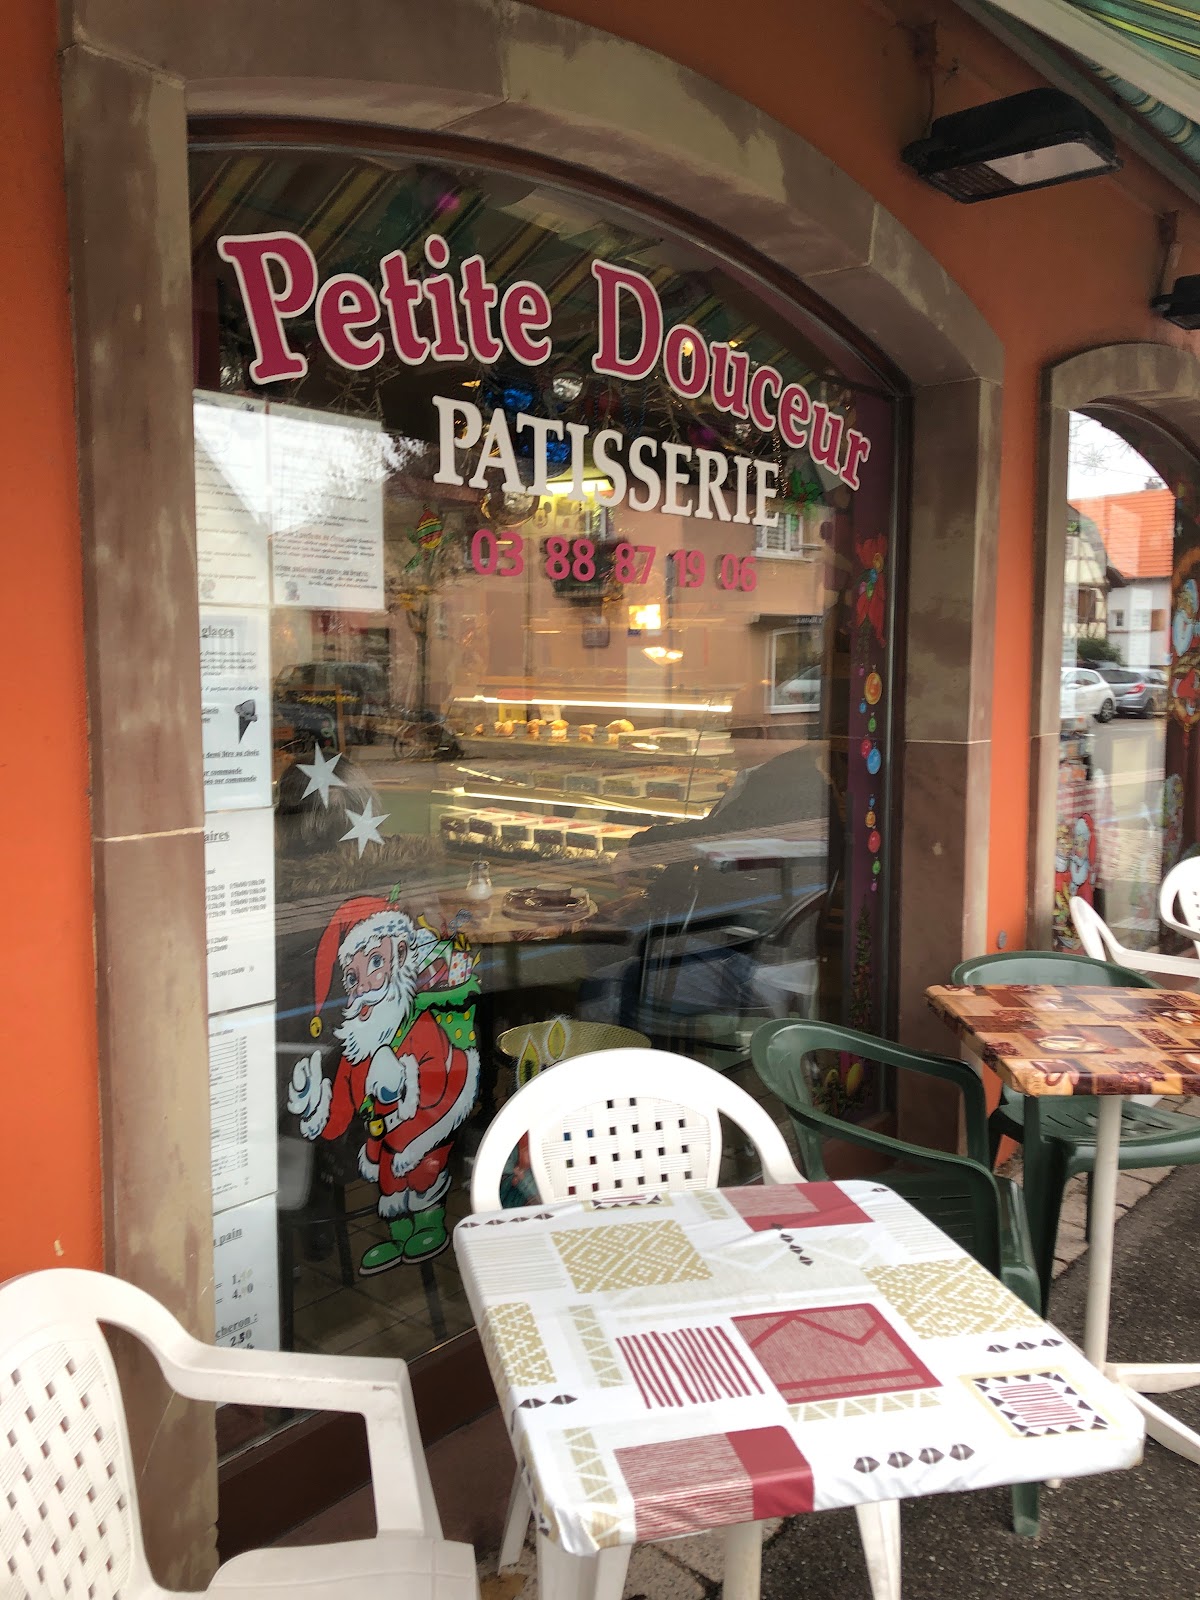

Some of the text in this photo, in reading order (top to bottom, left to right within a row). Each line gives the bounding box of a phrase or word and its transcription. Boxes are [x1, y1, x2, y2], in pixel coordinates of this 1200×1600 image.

[217, 231, 872, 492] Petite Douceur
[432, 395, 780, 528] PATISSERIE
[471, 529, 758, 593] 03 88 87 19 06
[204, 831, 230, 843] aires
[220, 1228, 243, 1245] pain
[215, 1316, 251, 1341] cheron
